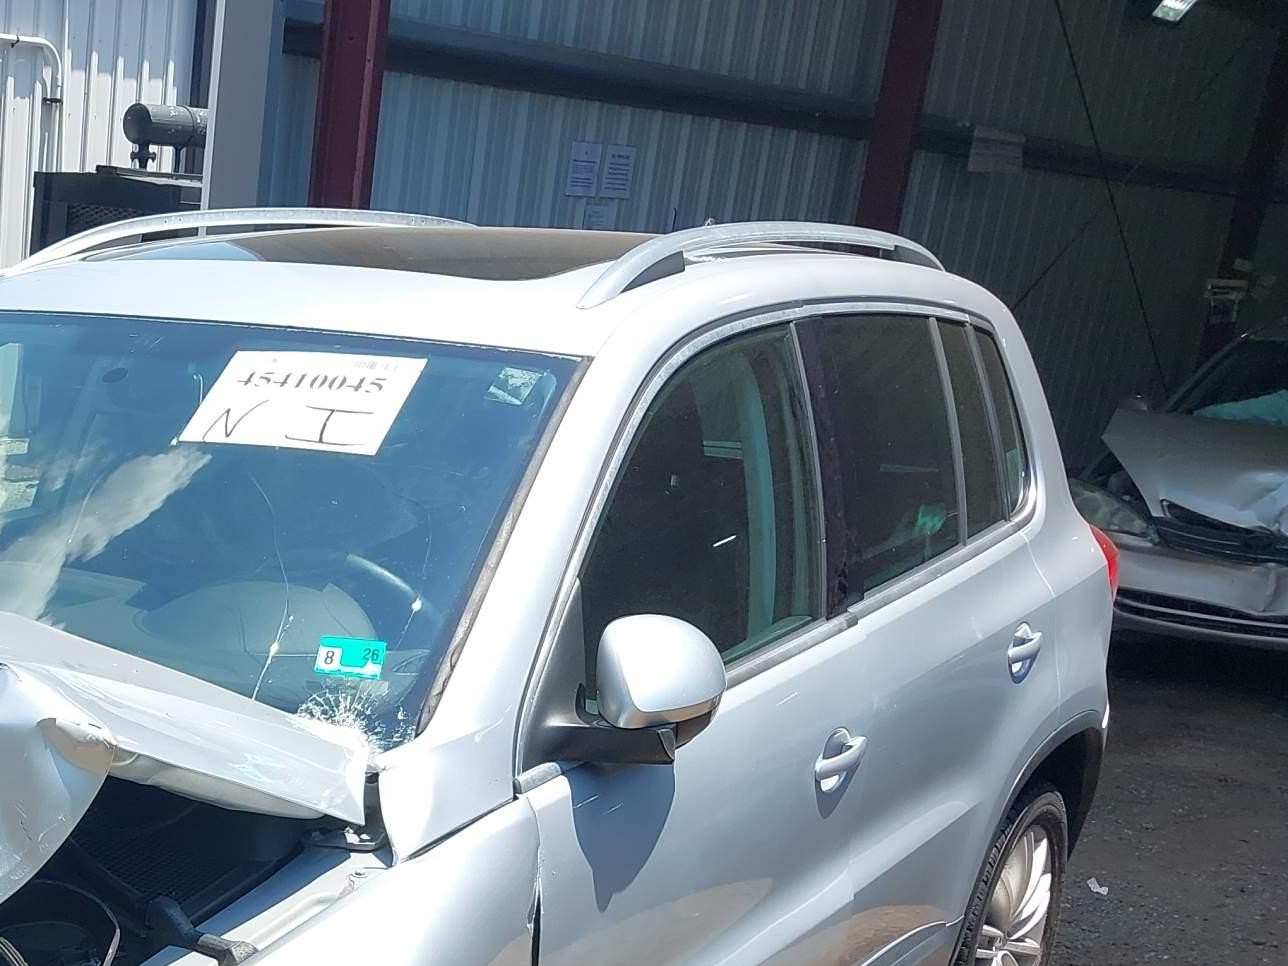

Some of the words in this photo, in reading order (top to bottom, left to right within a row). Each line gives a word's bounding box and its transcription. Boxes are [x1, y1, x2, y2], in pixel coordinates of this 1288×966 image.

[237, 371, 388, 393] 45410045
[202, 400, 270, 441] N
[323, 650, 335, 665] 8
[362, 647, 381, 662] 26
